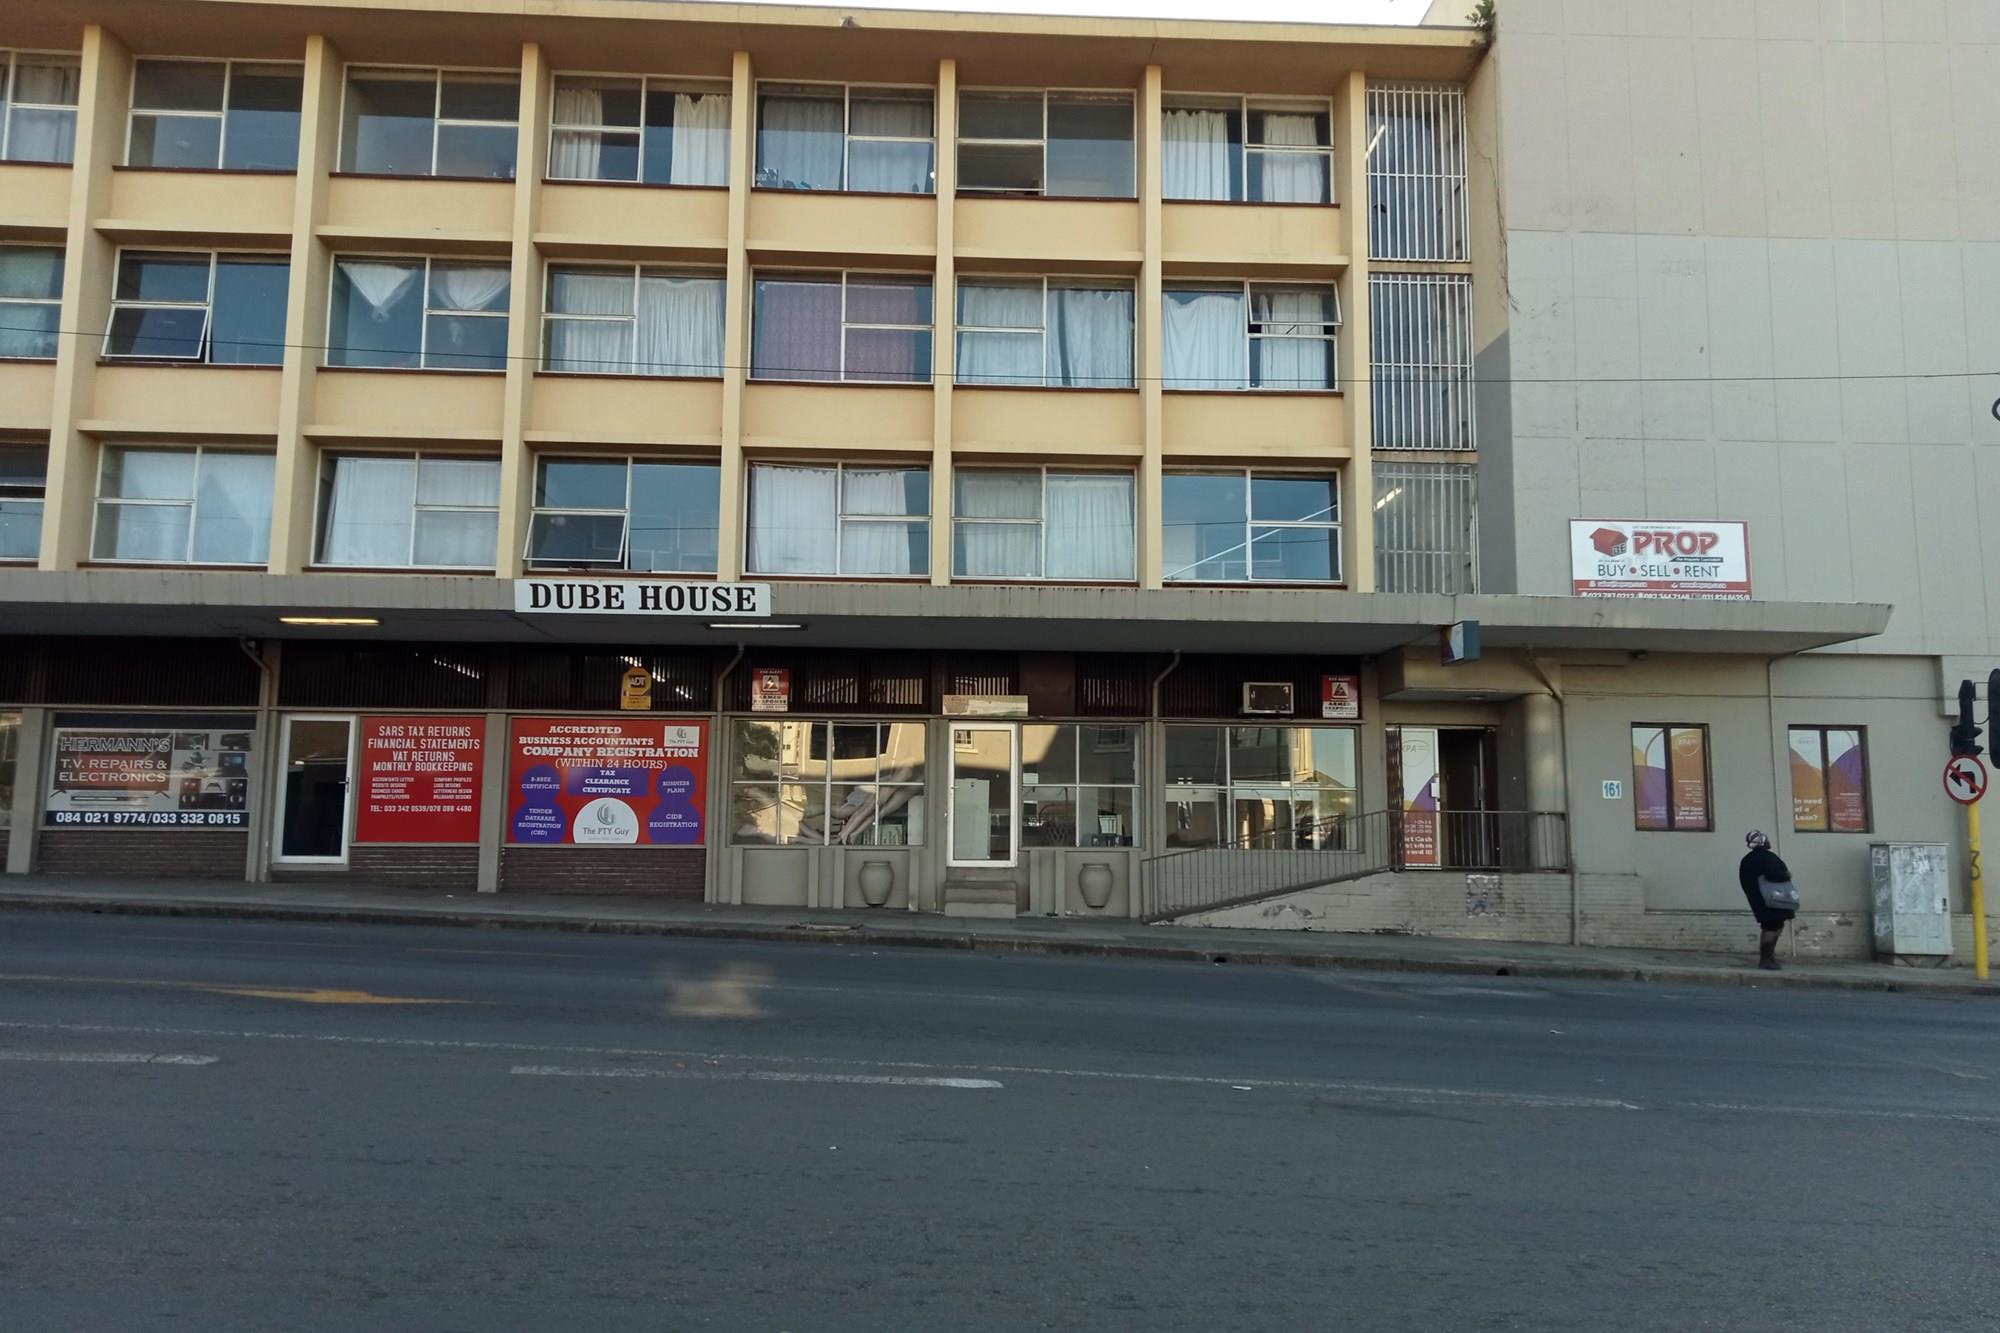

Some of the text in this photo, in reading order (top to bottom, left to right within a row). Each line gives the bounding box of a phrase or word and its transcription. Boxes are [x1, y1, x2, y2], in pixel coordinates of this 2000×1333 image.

[1632, 530, 1719, 557] PROP
[1598, 564, 1720, 578] BUY SELL RENT
[530, 583, 757, 612] DUBE HOUSE
[629, 677, 647, 686] ADT
[379, 726, 471, 737] SARS TAX RETURNS
[548, 726, 622, 734] ACCREDITED
[60, 736, 171, 752] HERMANN'S
[368, 738, 480, 749] FINANCIAL STATEMENTS
[518, 736, 654, 745] BUSINESS ACCOUNTANTS
[392, 751, 455, 762] VAT RETURNS
[522, 746, 698, 758] COMPANY REGISTRATION
[60, 758, 168, 769] T.V. REPAIRS &
[373, 762, 473, 772] MONTHLY BOOKKEEPING
[555, 758, 667, 771] (WITHIN 24 HOURS)
[59, 771, 167, 783] ELECTRONICS
[1604, 782, 1621, 797] 161
[56, 812, 241, 824] 084 021 9774/033 332 0815
[583, 827, 630, 837] The PTY Guy
